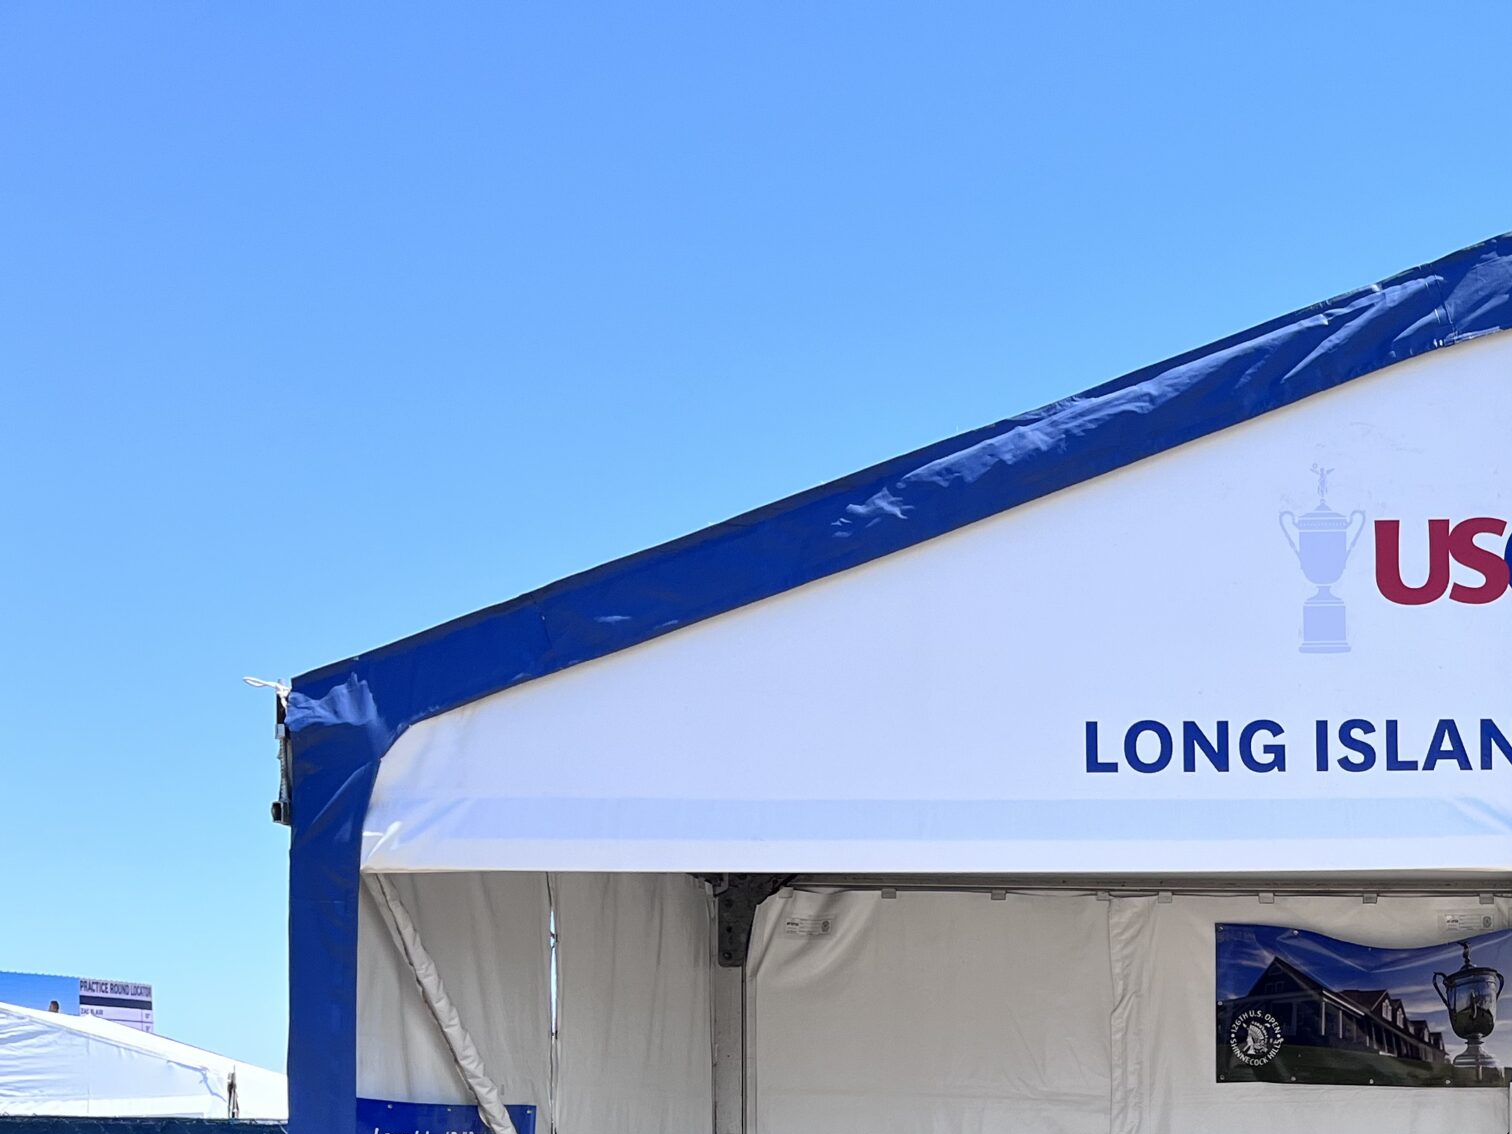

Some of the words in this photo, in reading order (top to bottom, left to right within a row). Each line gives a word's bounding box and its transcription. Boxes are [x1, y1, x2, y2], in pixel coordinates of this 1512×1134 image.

[1085, 720, 1287, 773] LONG
[80, 980, 109, 994] PRACTICE
[109, 982, 130, 996] ROUND
[1264, 1013, 1281, 1034] OPEN
